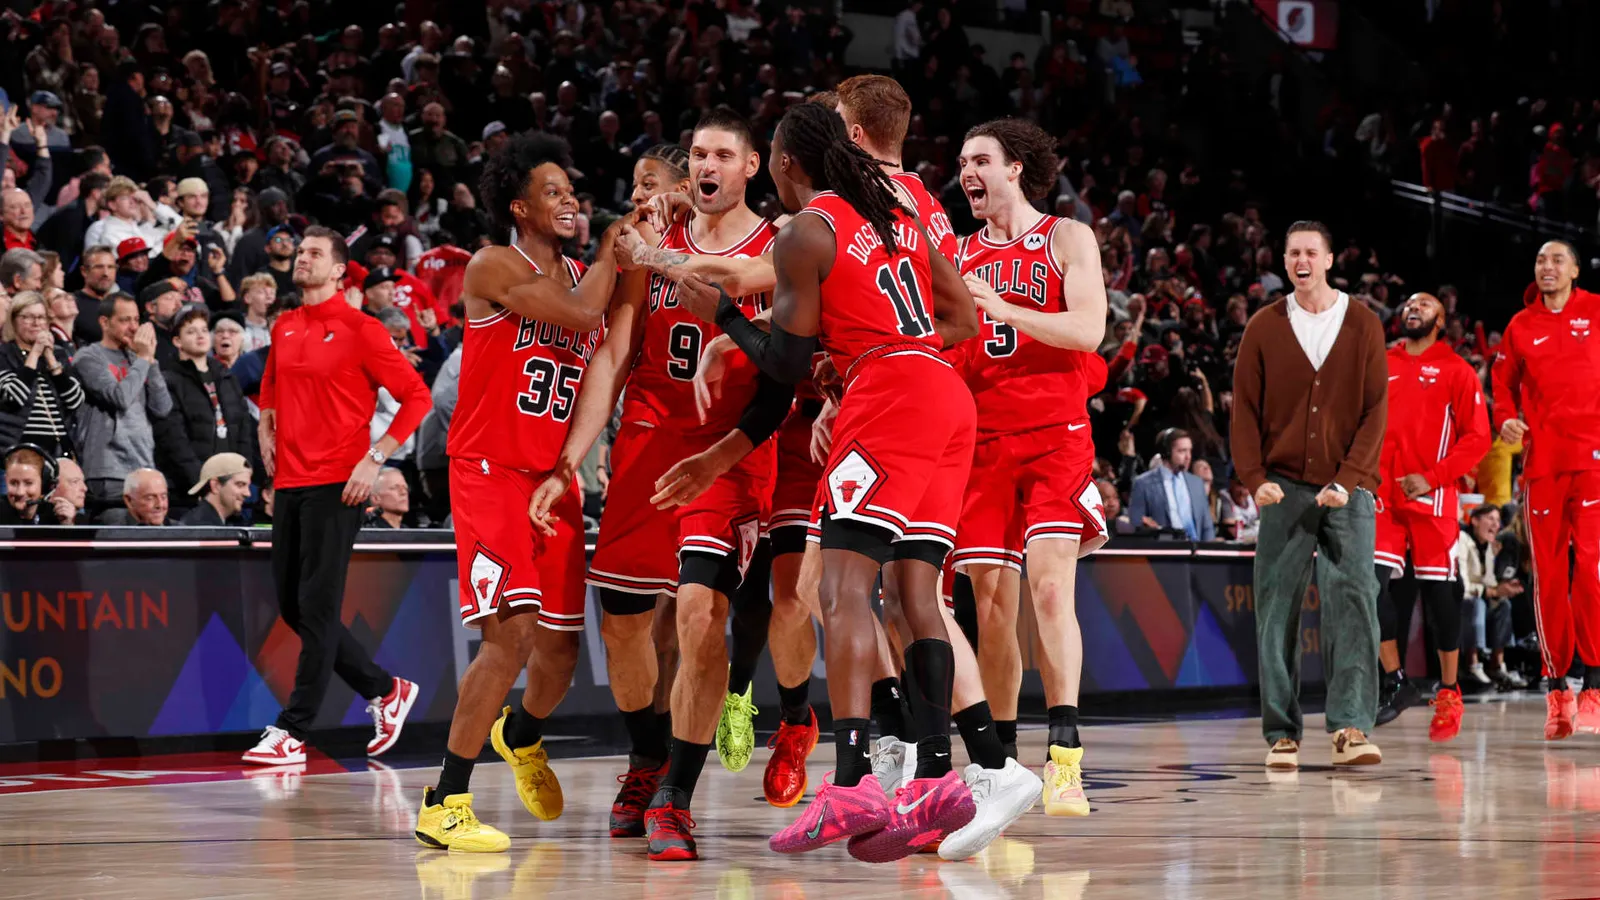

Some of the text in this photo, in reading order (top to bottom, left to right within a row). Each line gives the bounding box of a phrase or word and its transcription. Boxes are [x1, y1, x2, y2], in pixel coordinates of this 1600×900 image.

[847, 221, 919, 266] DOSUMU
[876, 256, 936, 339] 11
[975, 259, 1048, 306] ULLS
[667, 321, 703, 382] 9
[516, 355, 584, 423] 35
[1, 590, 169, 633] UNTAIN
[1224, 584, 1254, 613] SPI
[0, 656, 63, 699] NO
